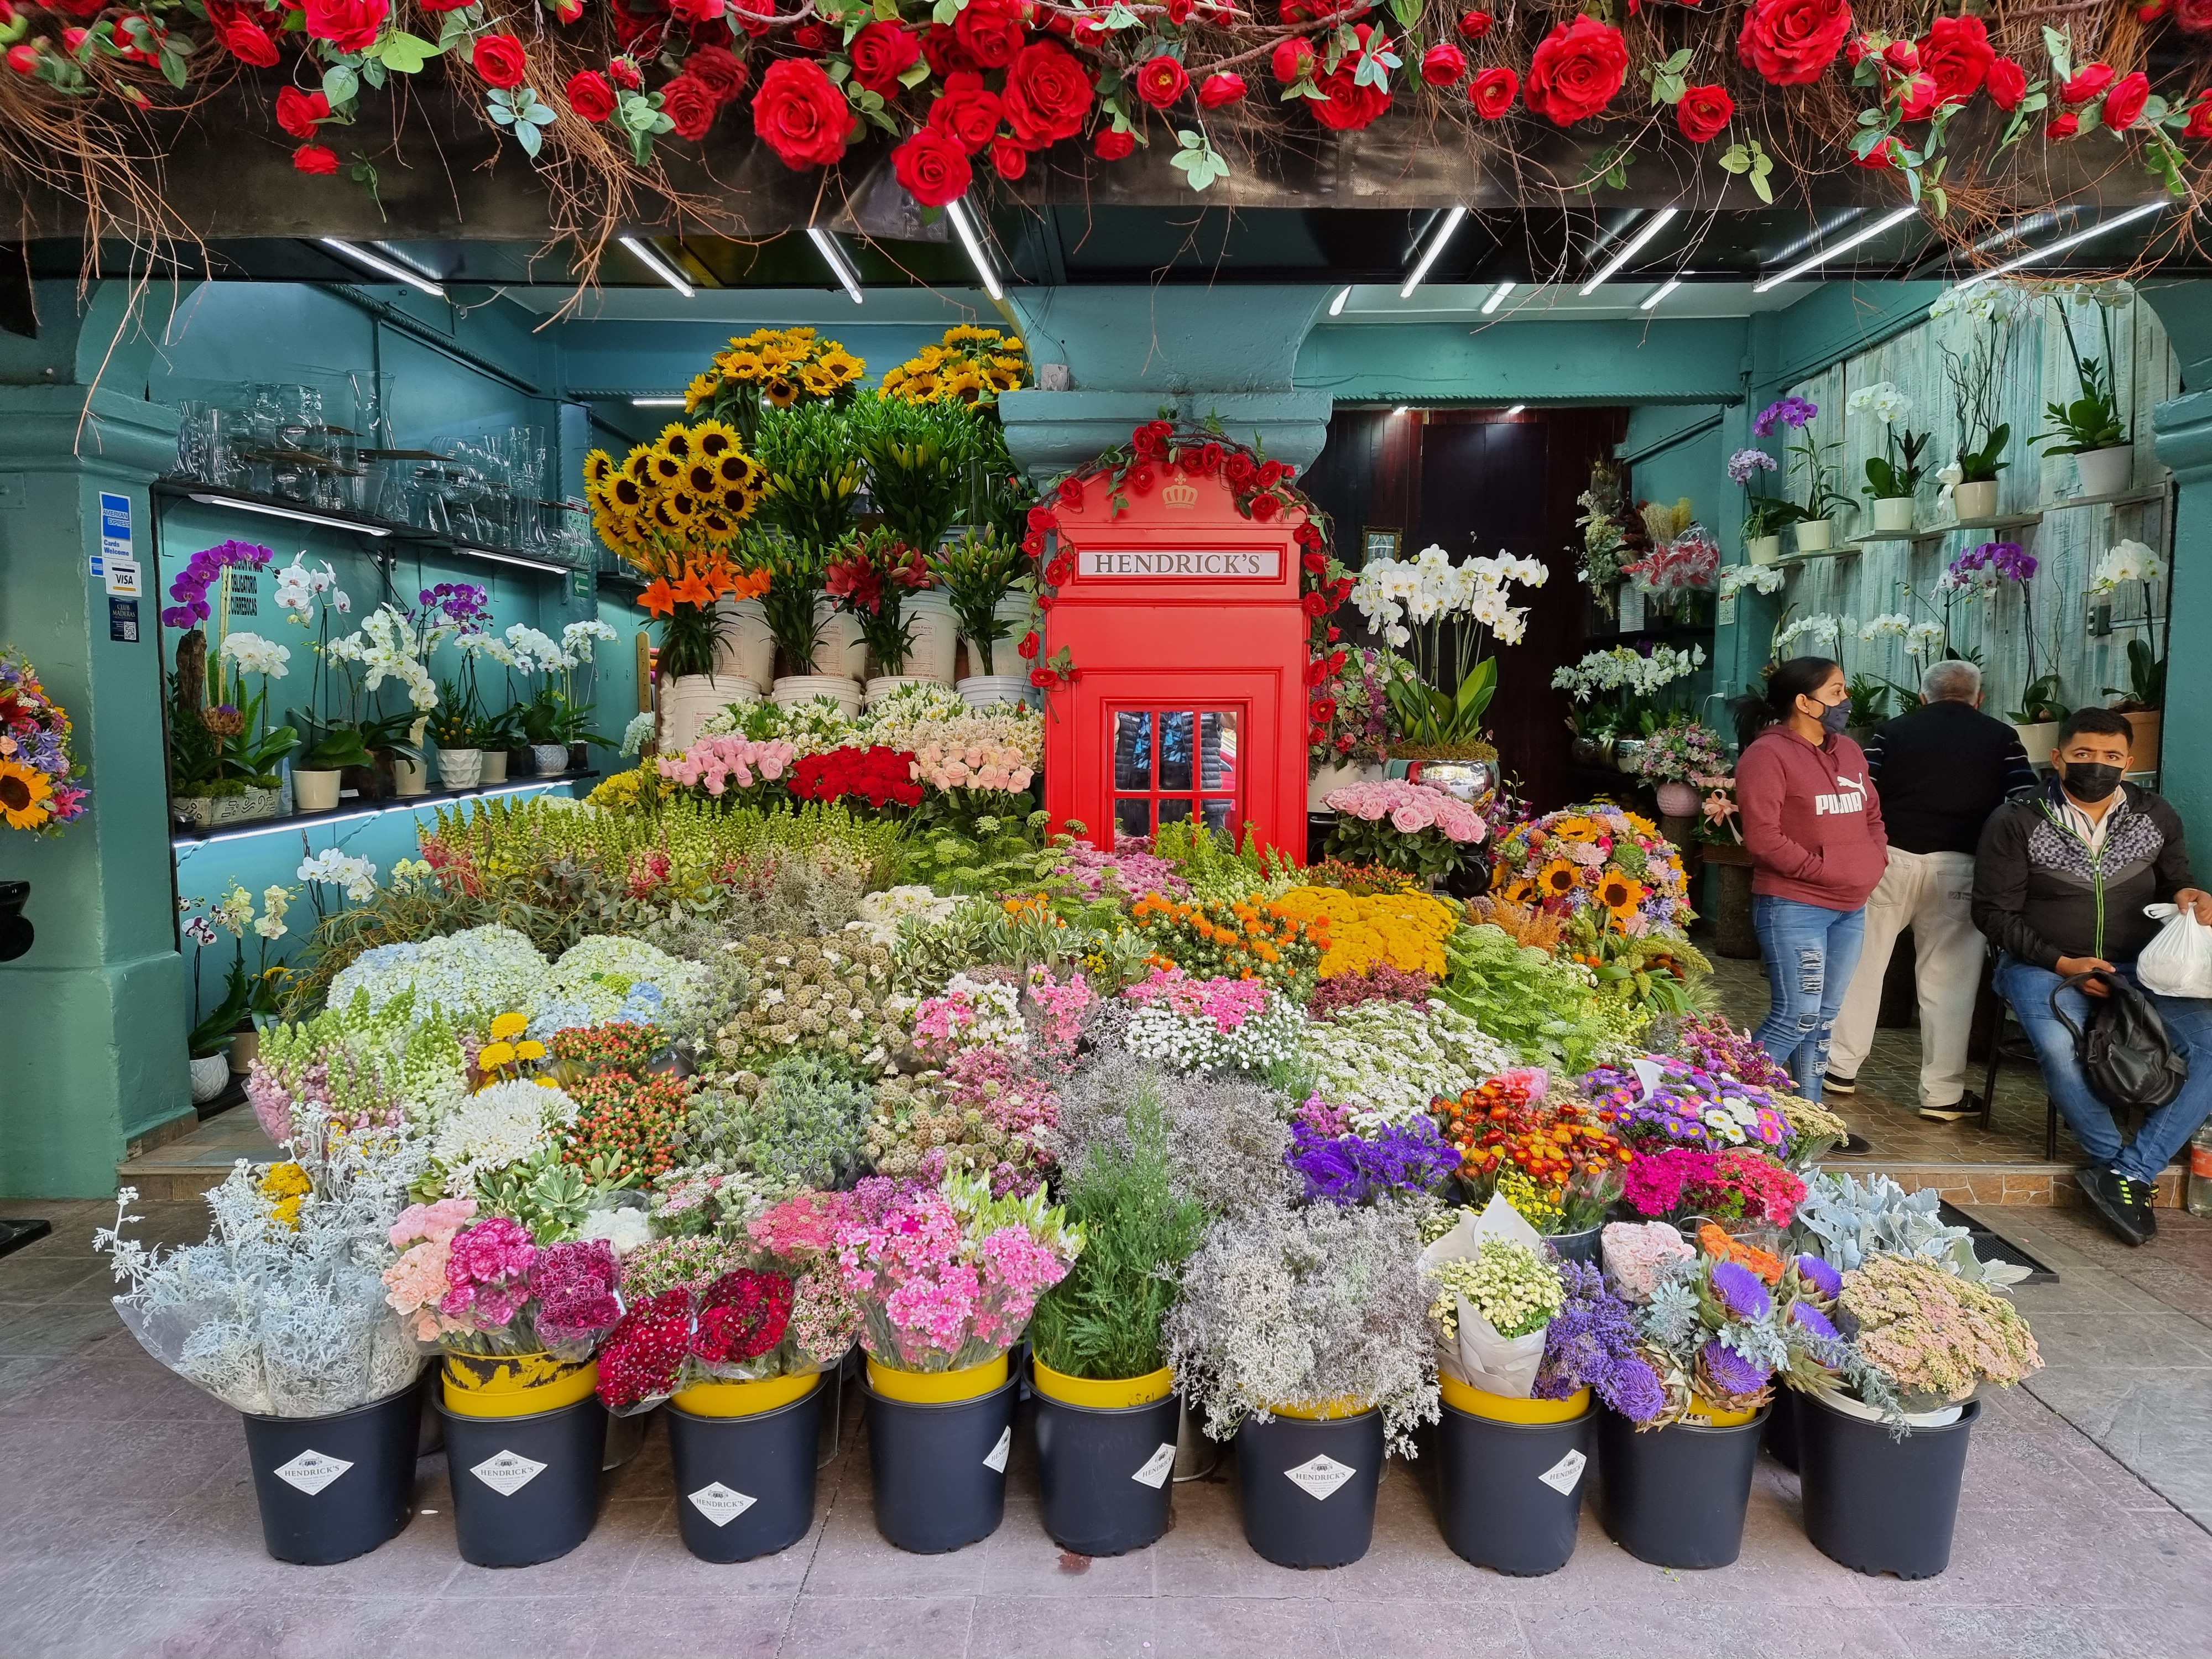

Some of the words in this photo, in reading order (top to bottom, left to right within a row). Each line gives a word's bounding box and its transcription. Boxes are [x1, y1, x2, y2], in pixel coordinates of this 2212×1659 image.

[103, 509, 128, 519] AMERICAN
[108, 519, 130, 527] EXPRESS
[103, 539, 120, 547] Cards
[103, 547, 129, 556] Welcome
[1095, 554, 1260, 574] HENDRICK'S
[114, 573, 134, 585] VISA
[231, 573, 257, 594] OBLIGATORIO
[231, 596, 257, 617] CUBREBOCAS
[1815, 791, 1863, 815] PUMA
[285, 1465, 340, 1477] HENDRICK'S
[481, 1467, 534, 1477] HENDRICK'S
[1296, 1472, 1345, 1480] HENDRICK'S
[696, 1498, 744, 1507] HENDRICK'S
